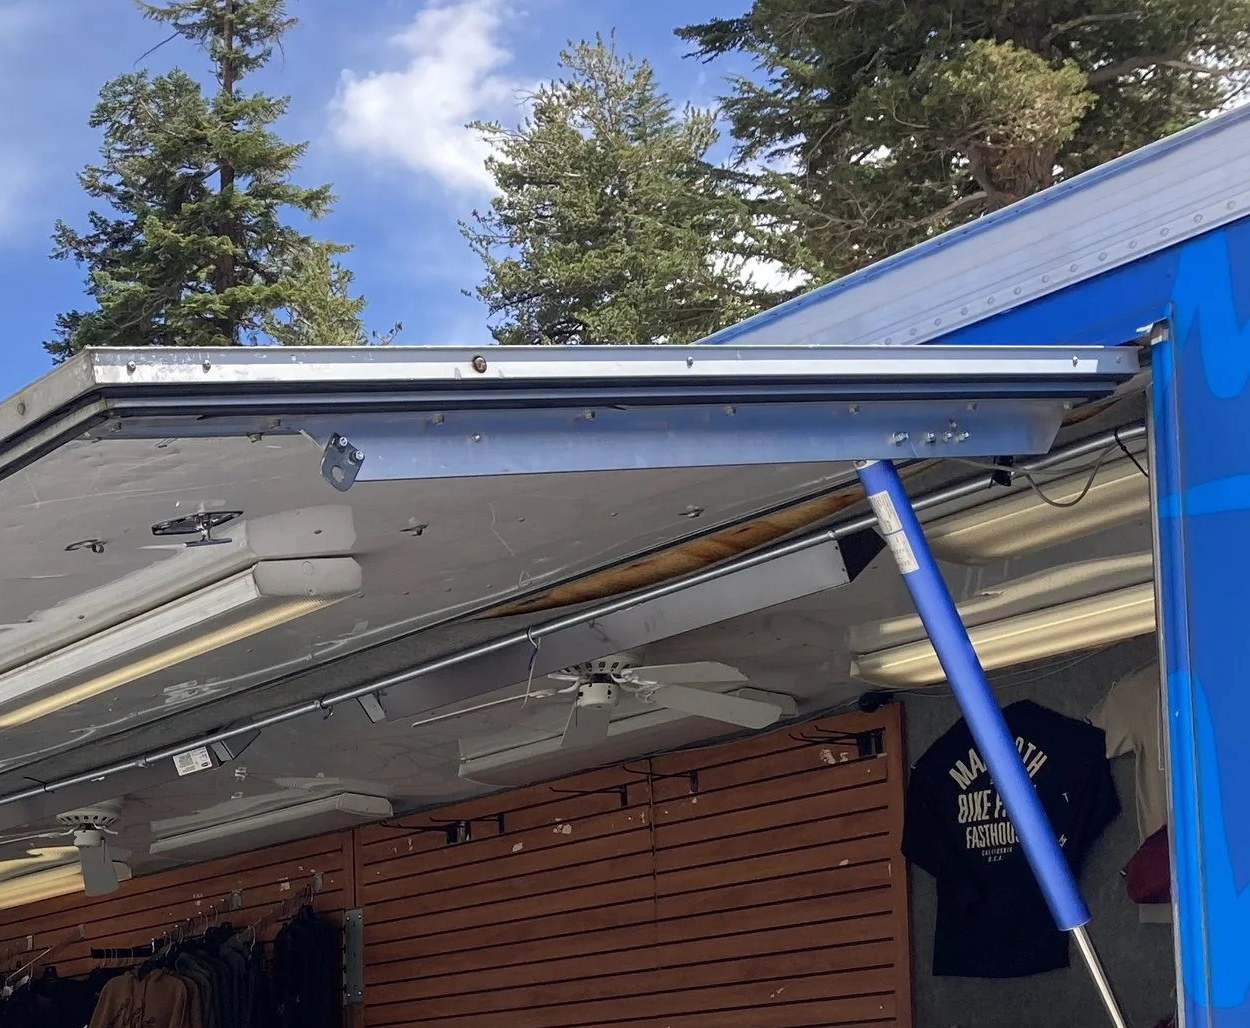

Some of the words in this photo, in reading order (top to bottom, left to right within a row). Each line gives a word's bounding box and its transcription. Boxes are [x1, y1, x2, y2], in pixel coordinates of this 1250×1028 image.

[949, 736, 1048, 790] MAOTH
[958, 790, 991, 824] BIKE
[966, 821, 1020, 849] FASTHOU
